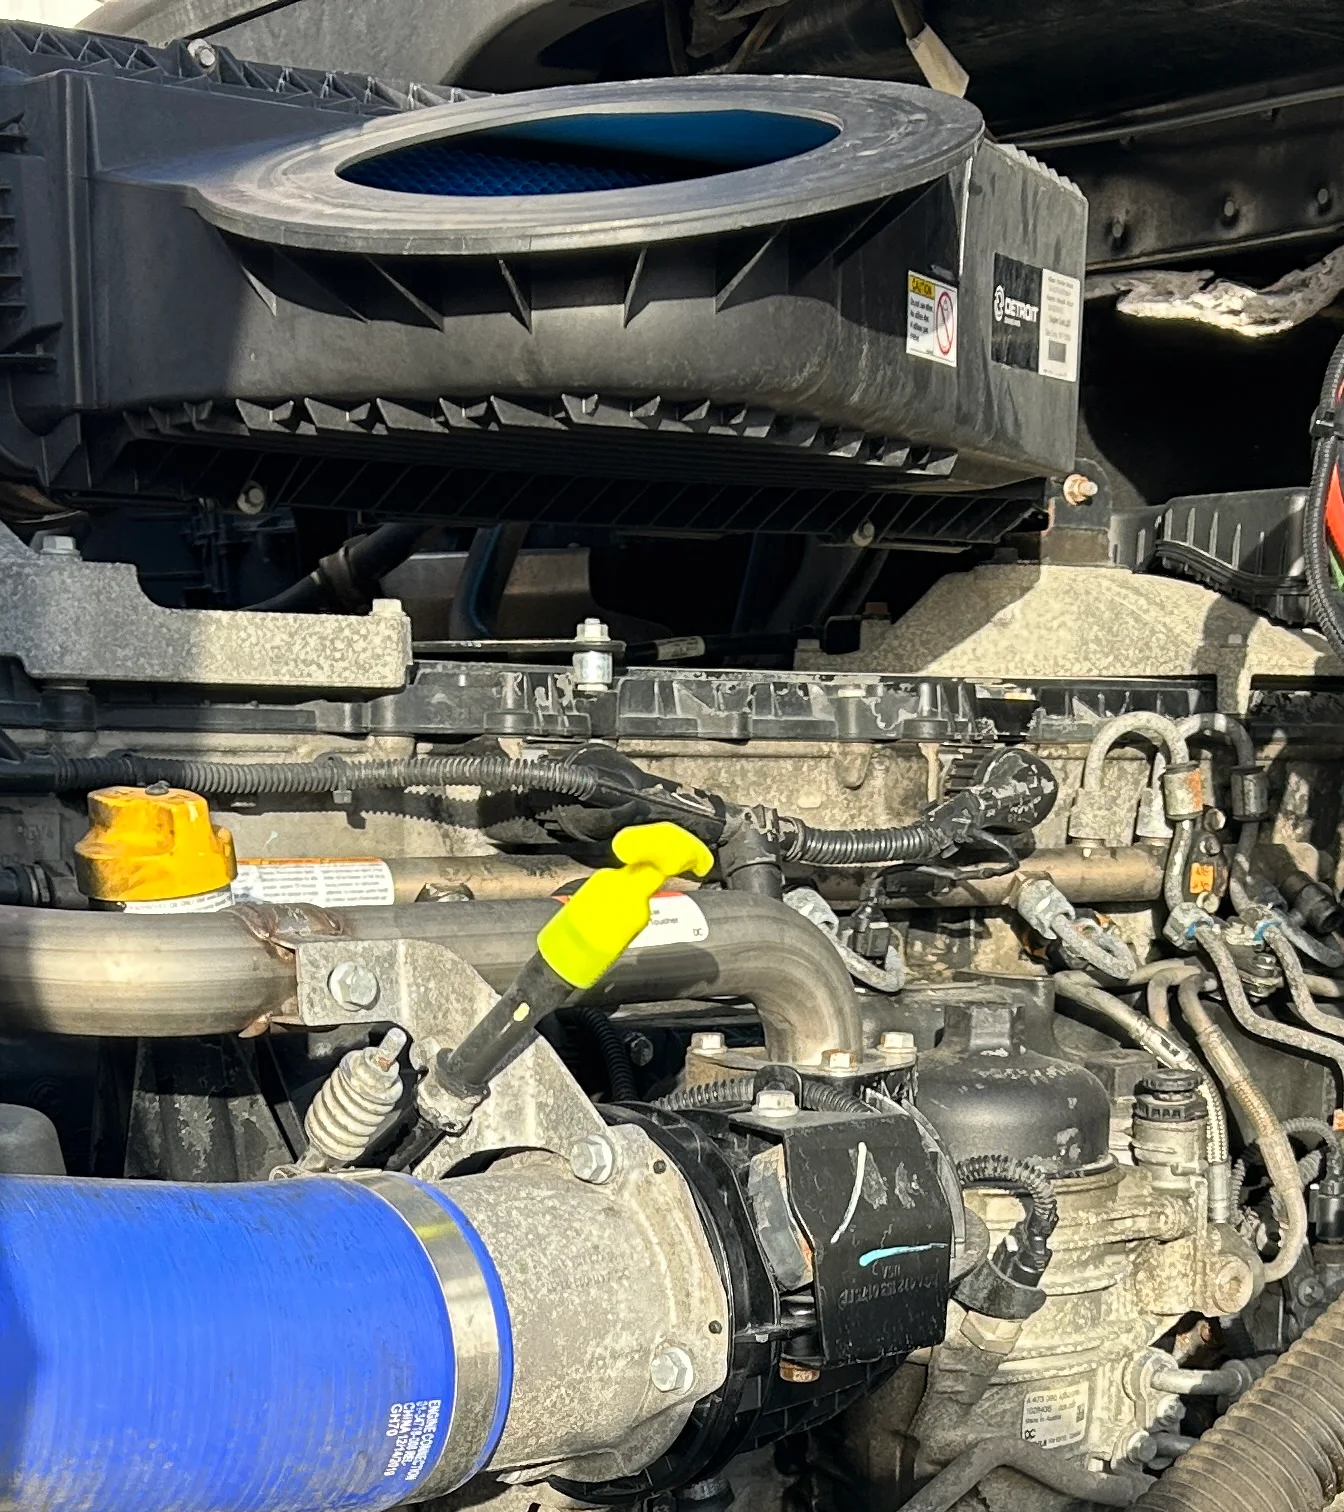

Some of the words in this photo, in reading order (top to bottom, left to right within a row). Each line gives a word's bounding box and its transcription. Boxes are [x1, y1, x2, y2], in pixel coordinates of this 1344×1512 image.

[1004, 296, 1039, 322] DETROIT
[398, 1402, 416, 1434] CHINA
[423, 1400, 442, 1433] ENGINE
[404, 1433, 435, 1480] CONNECTION
